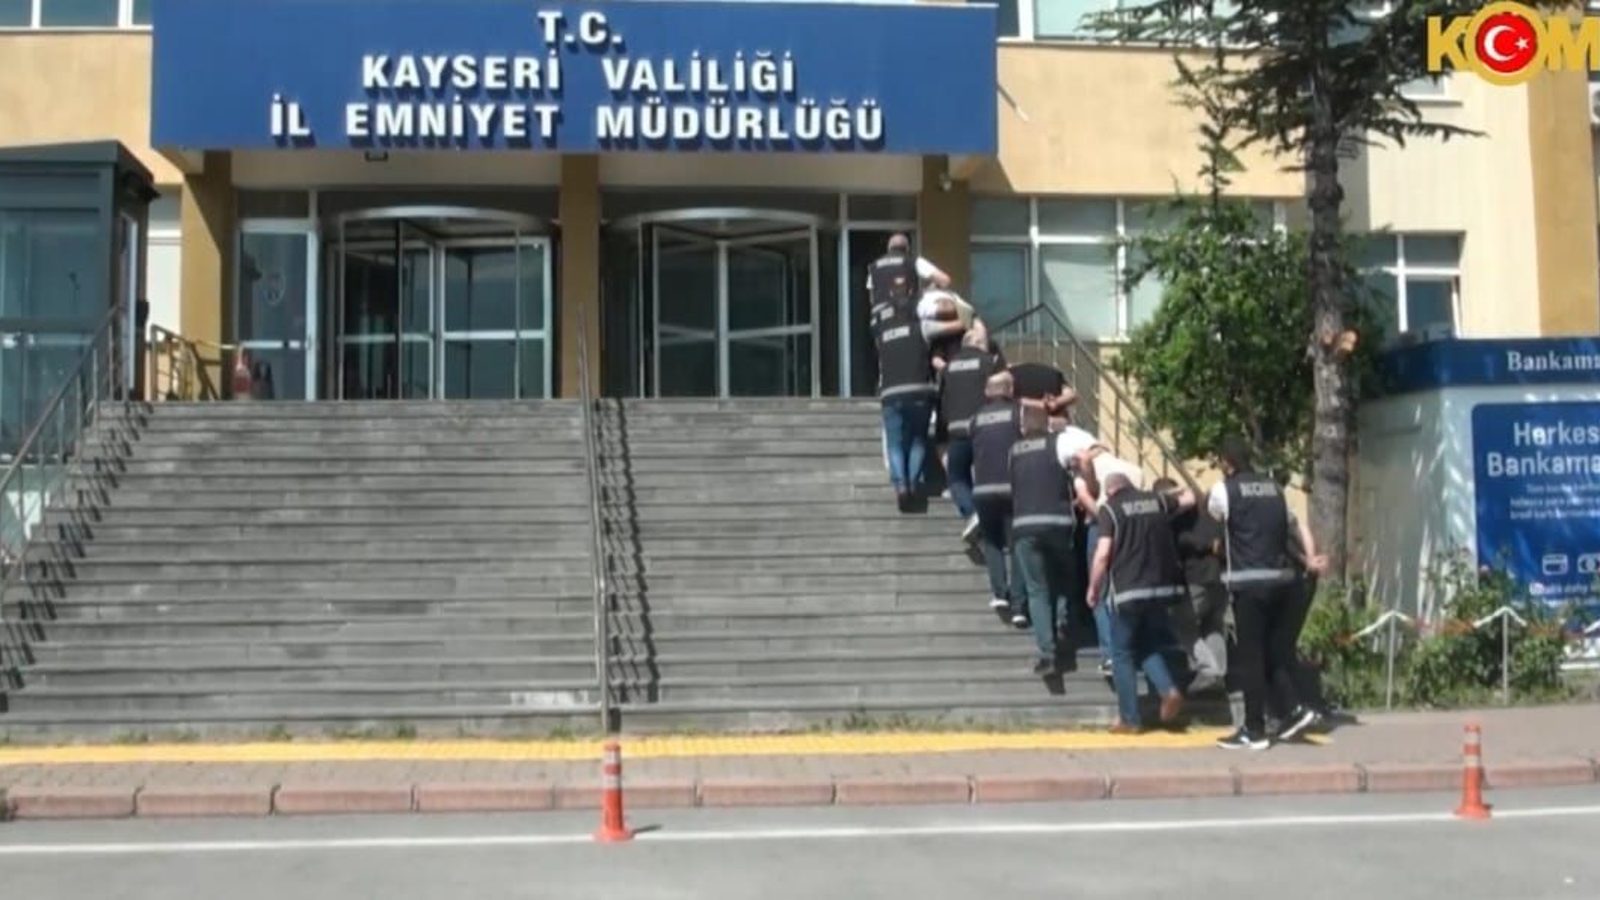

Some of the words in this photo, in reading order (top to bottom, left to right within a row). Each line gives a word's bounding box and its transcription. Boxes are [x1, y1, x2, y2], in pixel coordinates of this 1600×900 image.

[537, 10, 623, 44] T.C.
[362, 49, 560, 89] KAYSERİ
[602, 50, 795, 92] VALİLİĞİ
[270, 93, 311, 136] İL
[345, 94, 560, 137] EMNİYET
[597, 97, 883, 140] MÜDÜRLÜĞÜ
